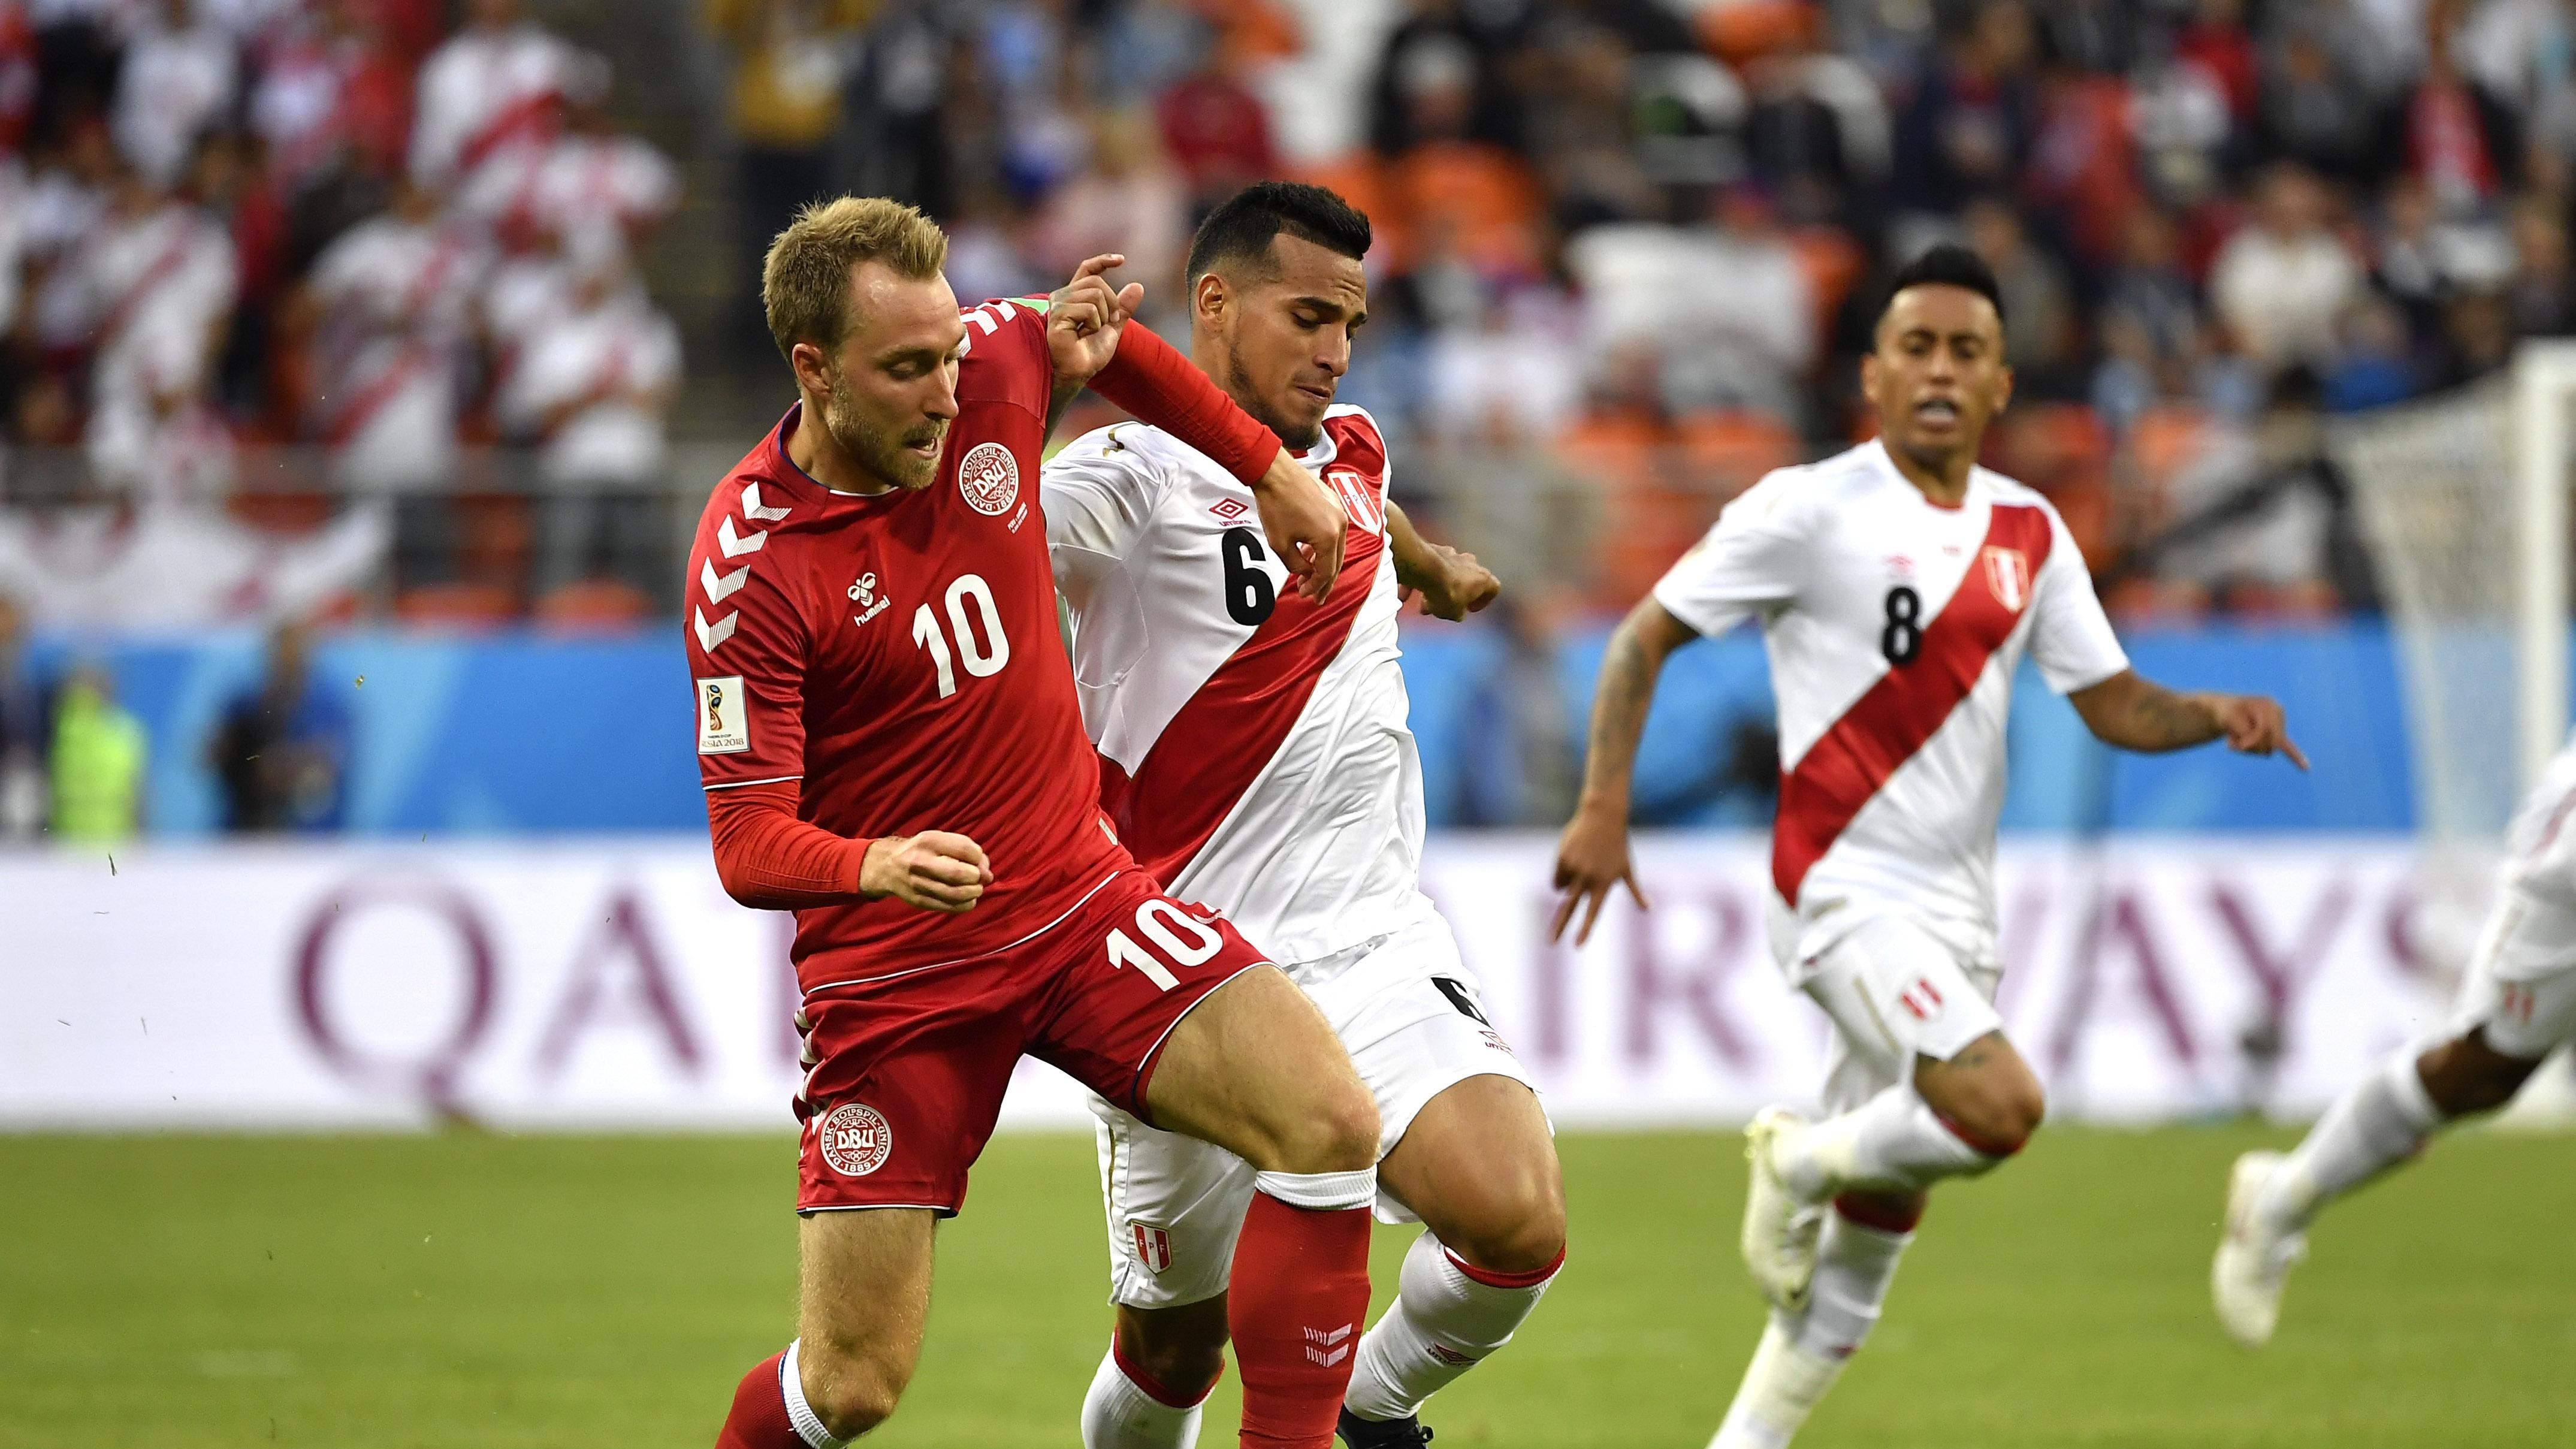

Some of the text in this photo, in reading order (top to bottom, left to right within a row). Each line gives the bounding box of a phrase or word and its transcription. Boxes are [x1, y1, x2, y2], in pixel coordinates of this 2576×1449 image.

[973, 460, 1007, 497] DBU
[999, 452, 1016, 486] UNION
[964, 482, 992, 511] DANSK
[997, 490, 1014, 510] 1889
[1222, 527, 1275, 626] 6
[854, 594, 891, 627] hummel
[1884, 586, 1922, 665] 8
[913, 573, 1010, 699] 10
[724, 738, 744, 747] 2018
[1106, 899, 1223, 992] 10
[825, 1127, 842, 1165] DANSK
[836, 1129, 875, 1149] DBU
[872, 1126, 887, 1163] UNION
[844, 1162, 871, 1172] 1889
